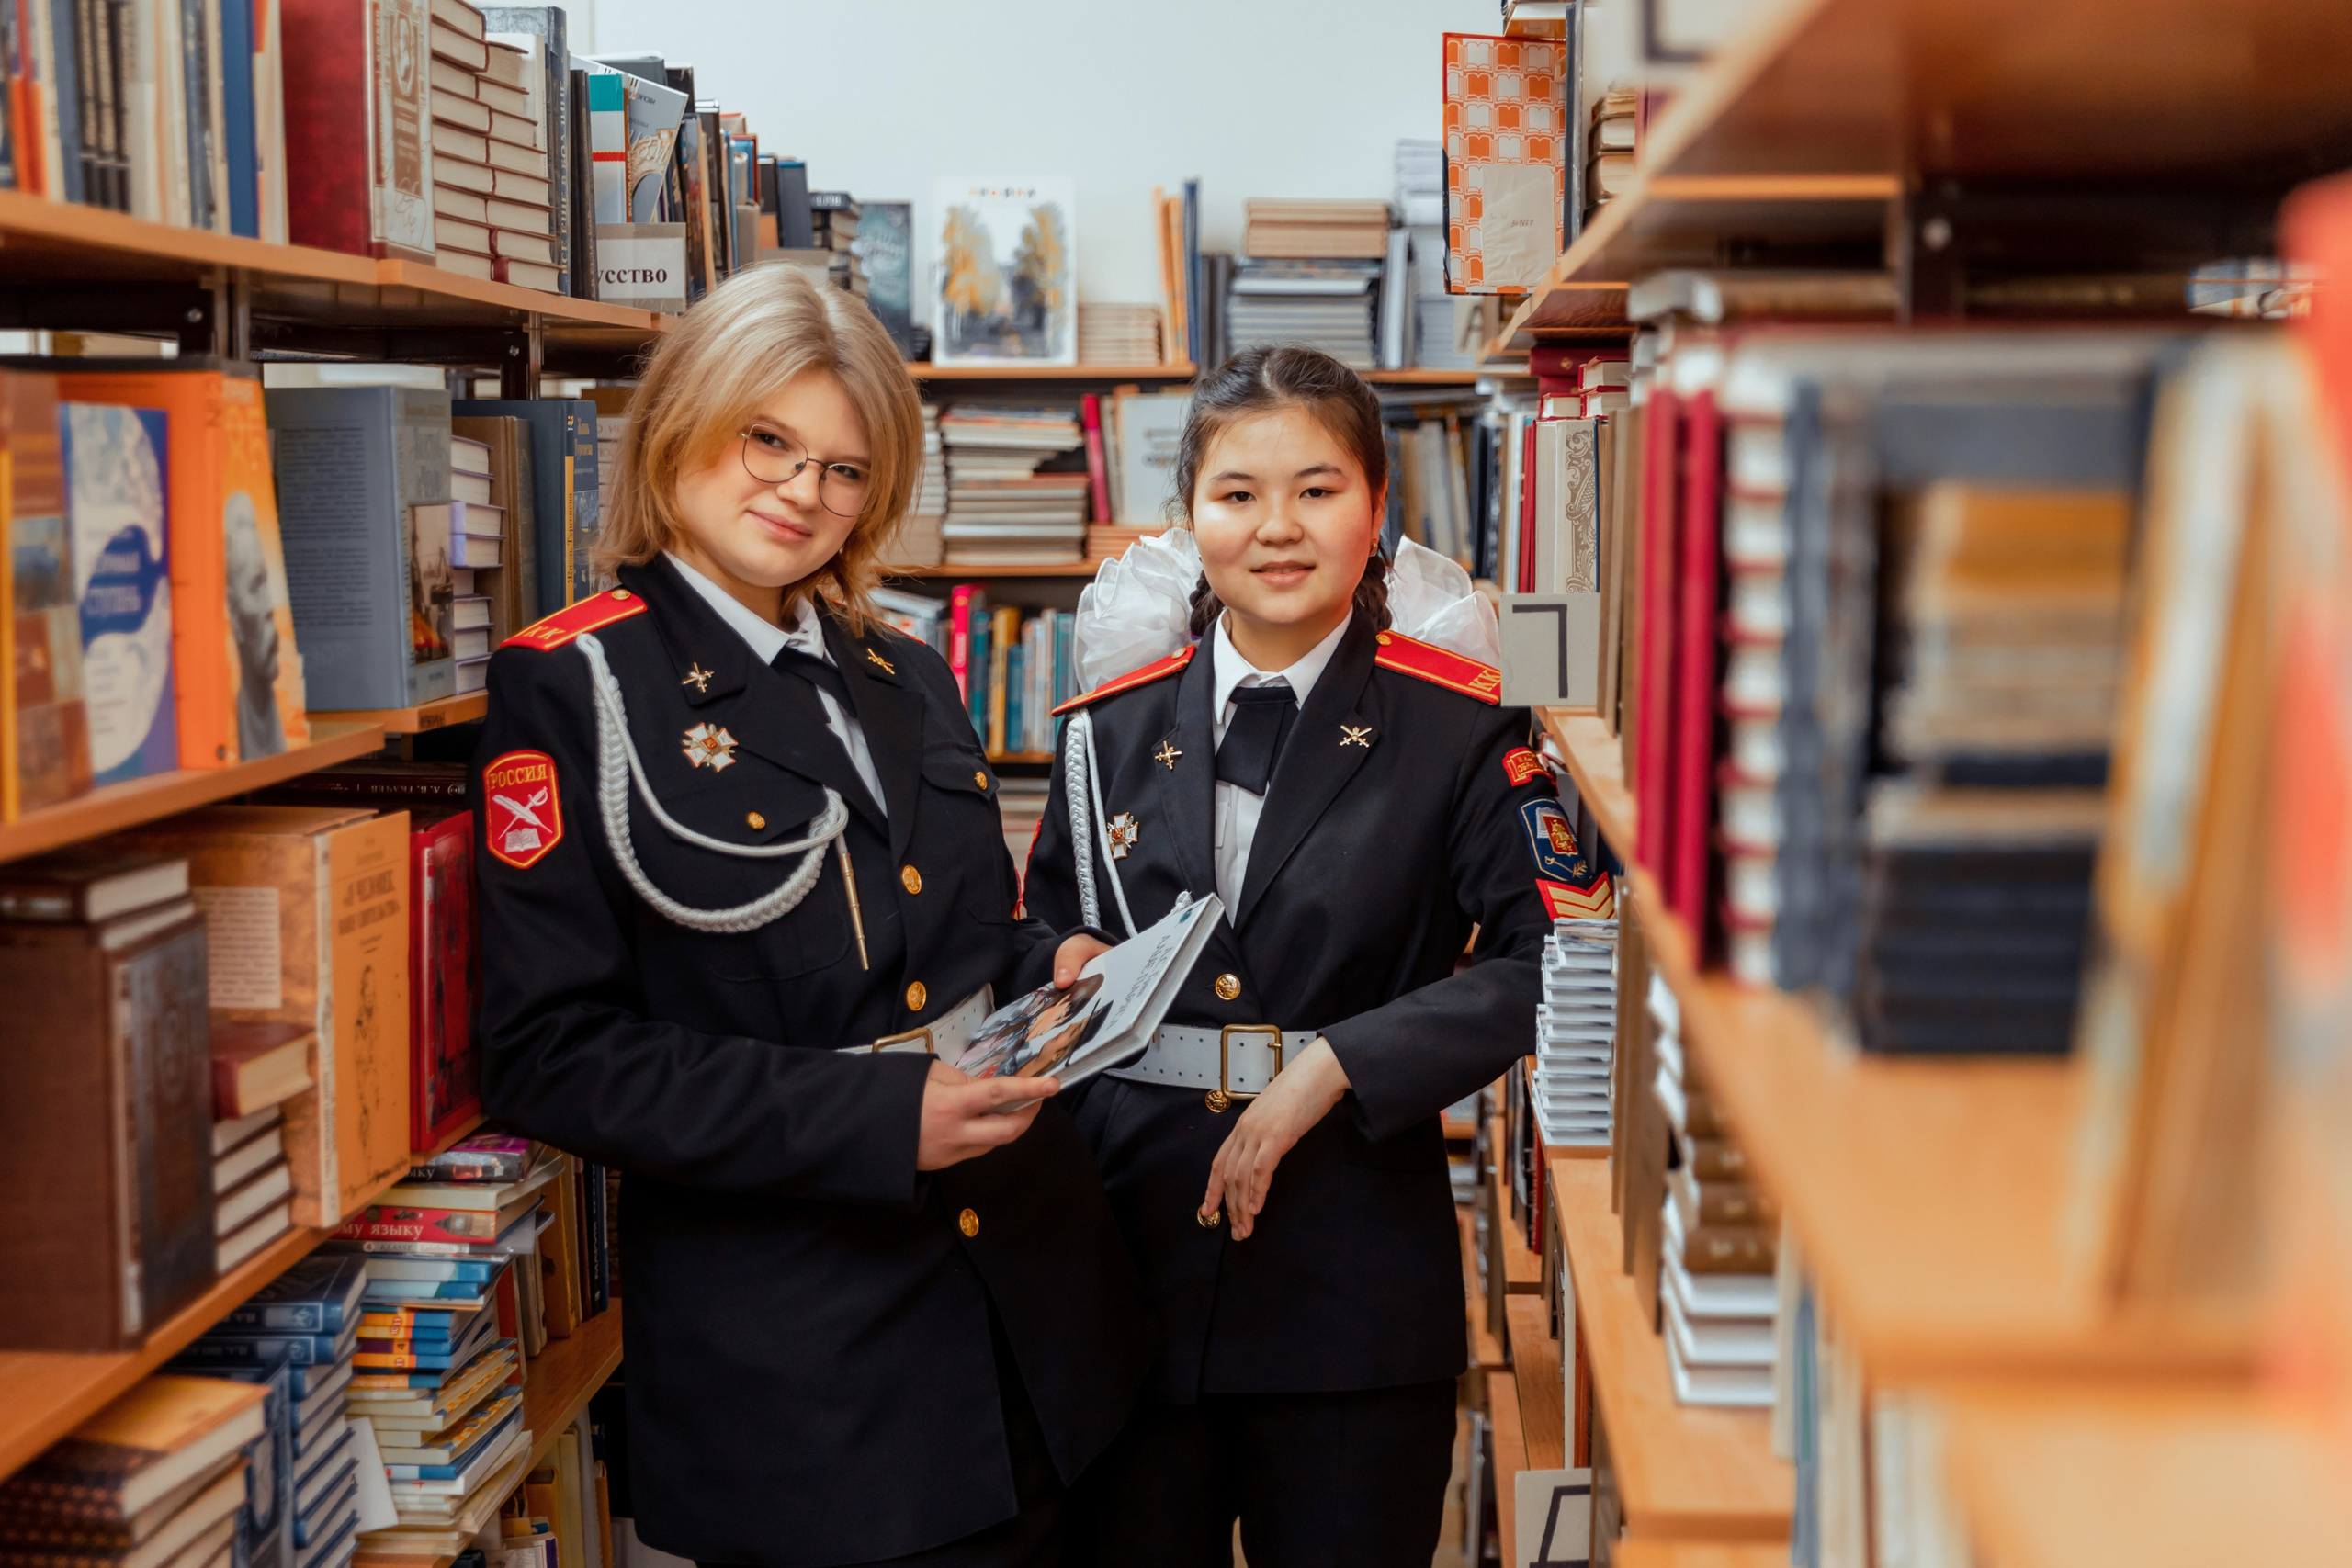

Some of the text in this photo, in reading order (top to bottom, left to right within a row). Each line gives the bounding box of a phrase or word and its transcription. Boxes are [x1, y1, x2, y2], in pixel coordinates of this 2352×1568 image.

[490, 763, 548, 790] РОССИЯ
[1105, 934, 1171, 1031] АЛЫЕ ПАРУСА
[370, 1224, 424, 1241] языку
